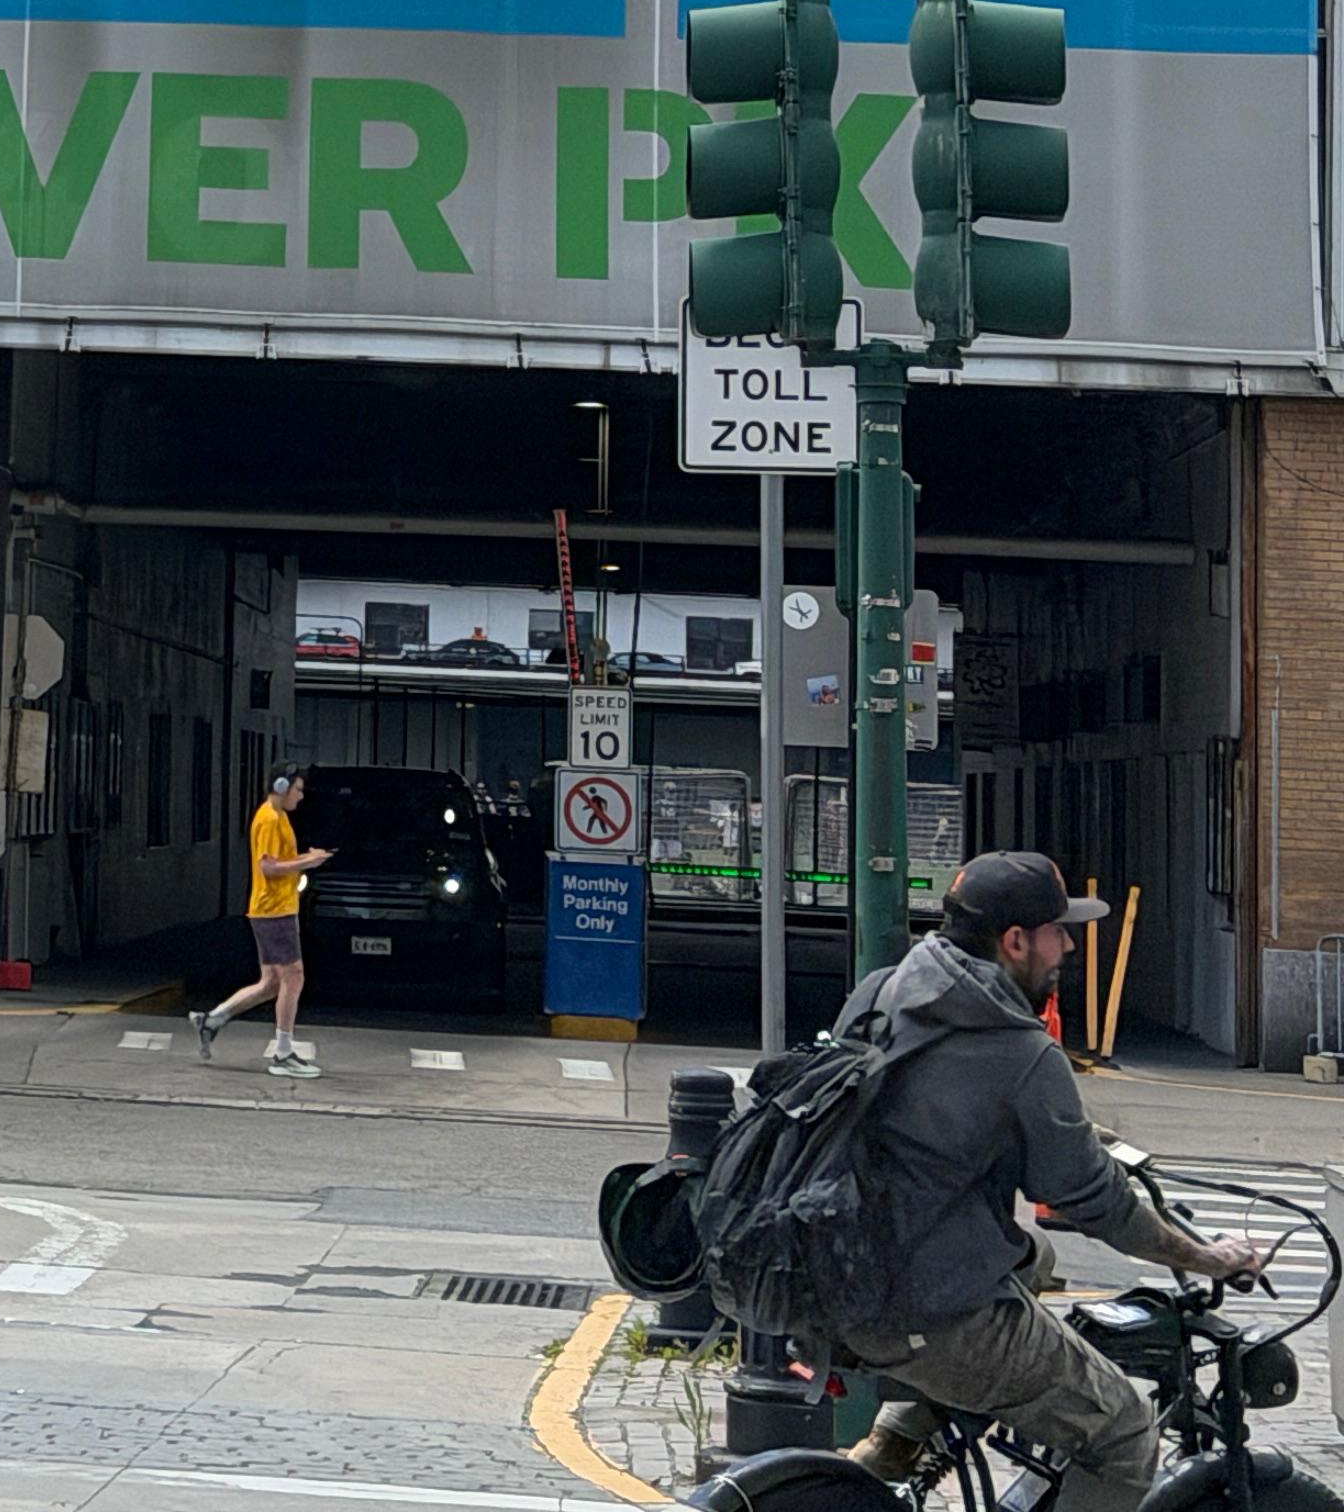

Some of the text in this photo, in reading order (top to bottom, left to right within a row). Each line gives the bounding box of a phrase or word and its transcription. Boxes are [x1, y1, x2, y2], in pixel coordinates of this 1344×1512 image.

[715, 368, 828, 401] TOLL
[710, 420, 832, 454] ZONE
[574, 695, 627, 710] SPEED
[580, 713, 620, 727] LIMIT
[580, 730, 620, 761] 10
[562, 874, 629, 896] Monthly
[562, 894, 629, 915] Parking
[575, 913, 615, 933] Only
